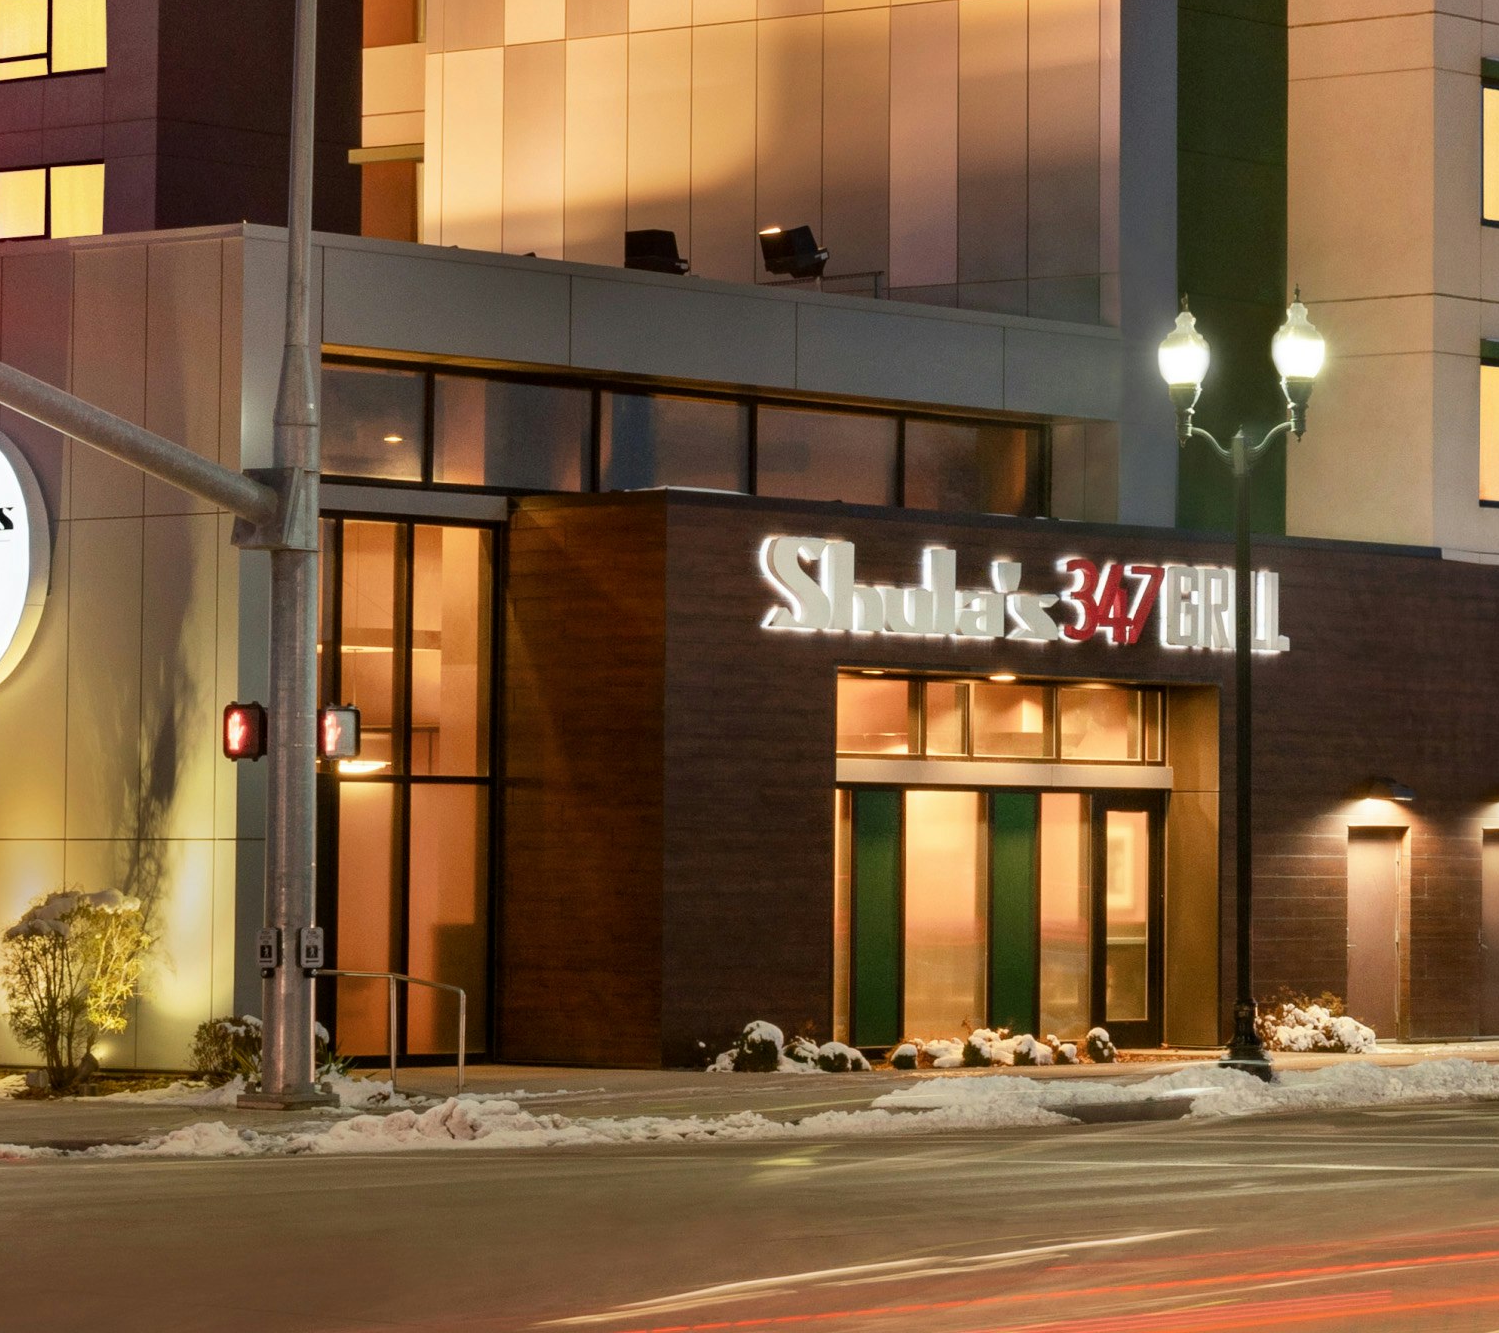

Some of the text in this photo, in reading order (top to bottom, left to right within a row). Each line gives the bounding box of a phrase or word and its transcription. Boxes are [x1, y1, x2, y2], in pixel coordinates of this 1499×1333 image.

[760, 536, 1290, 652] Shula's 347 GRLL
